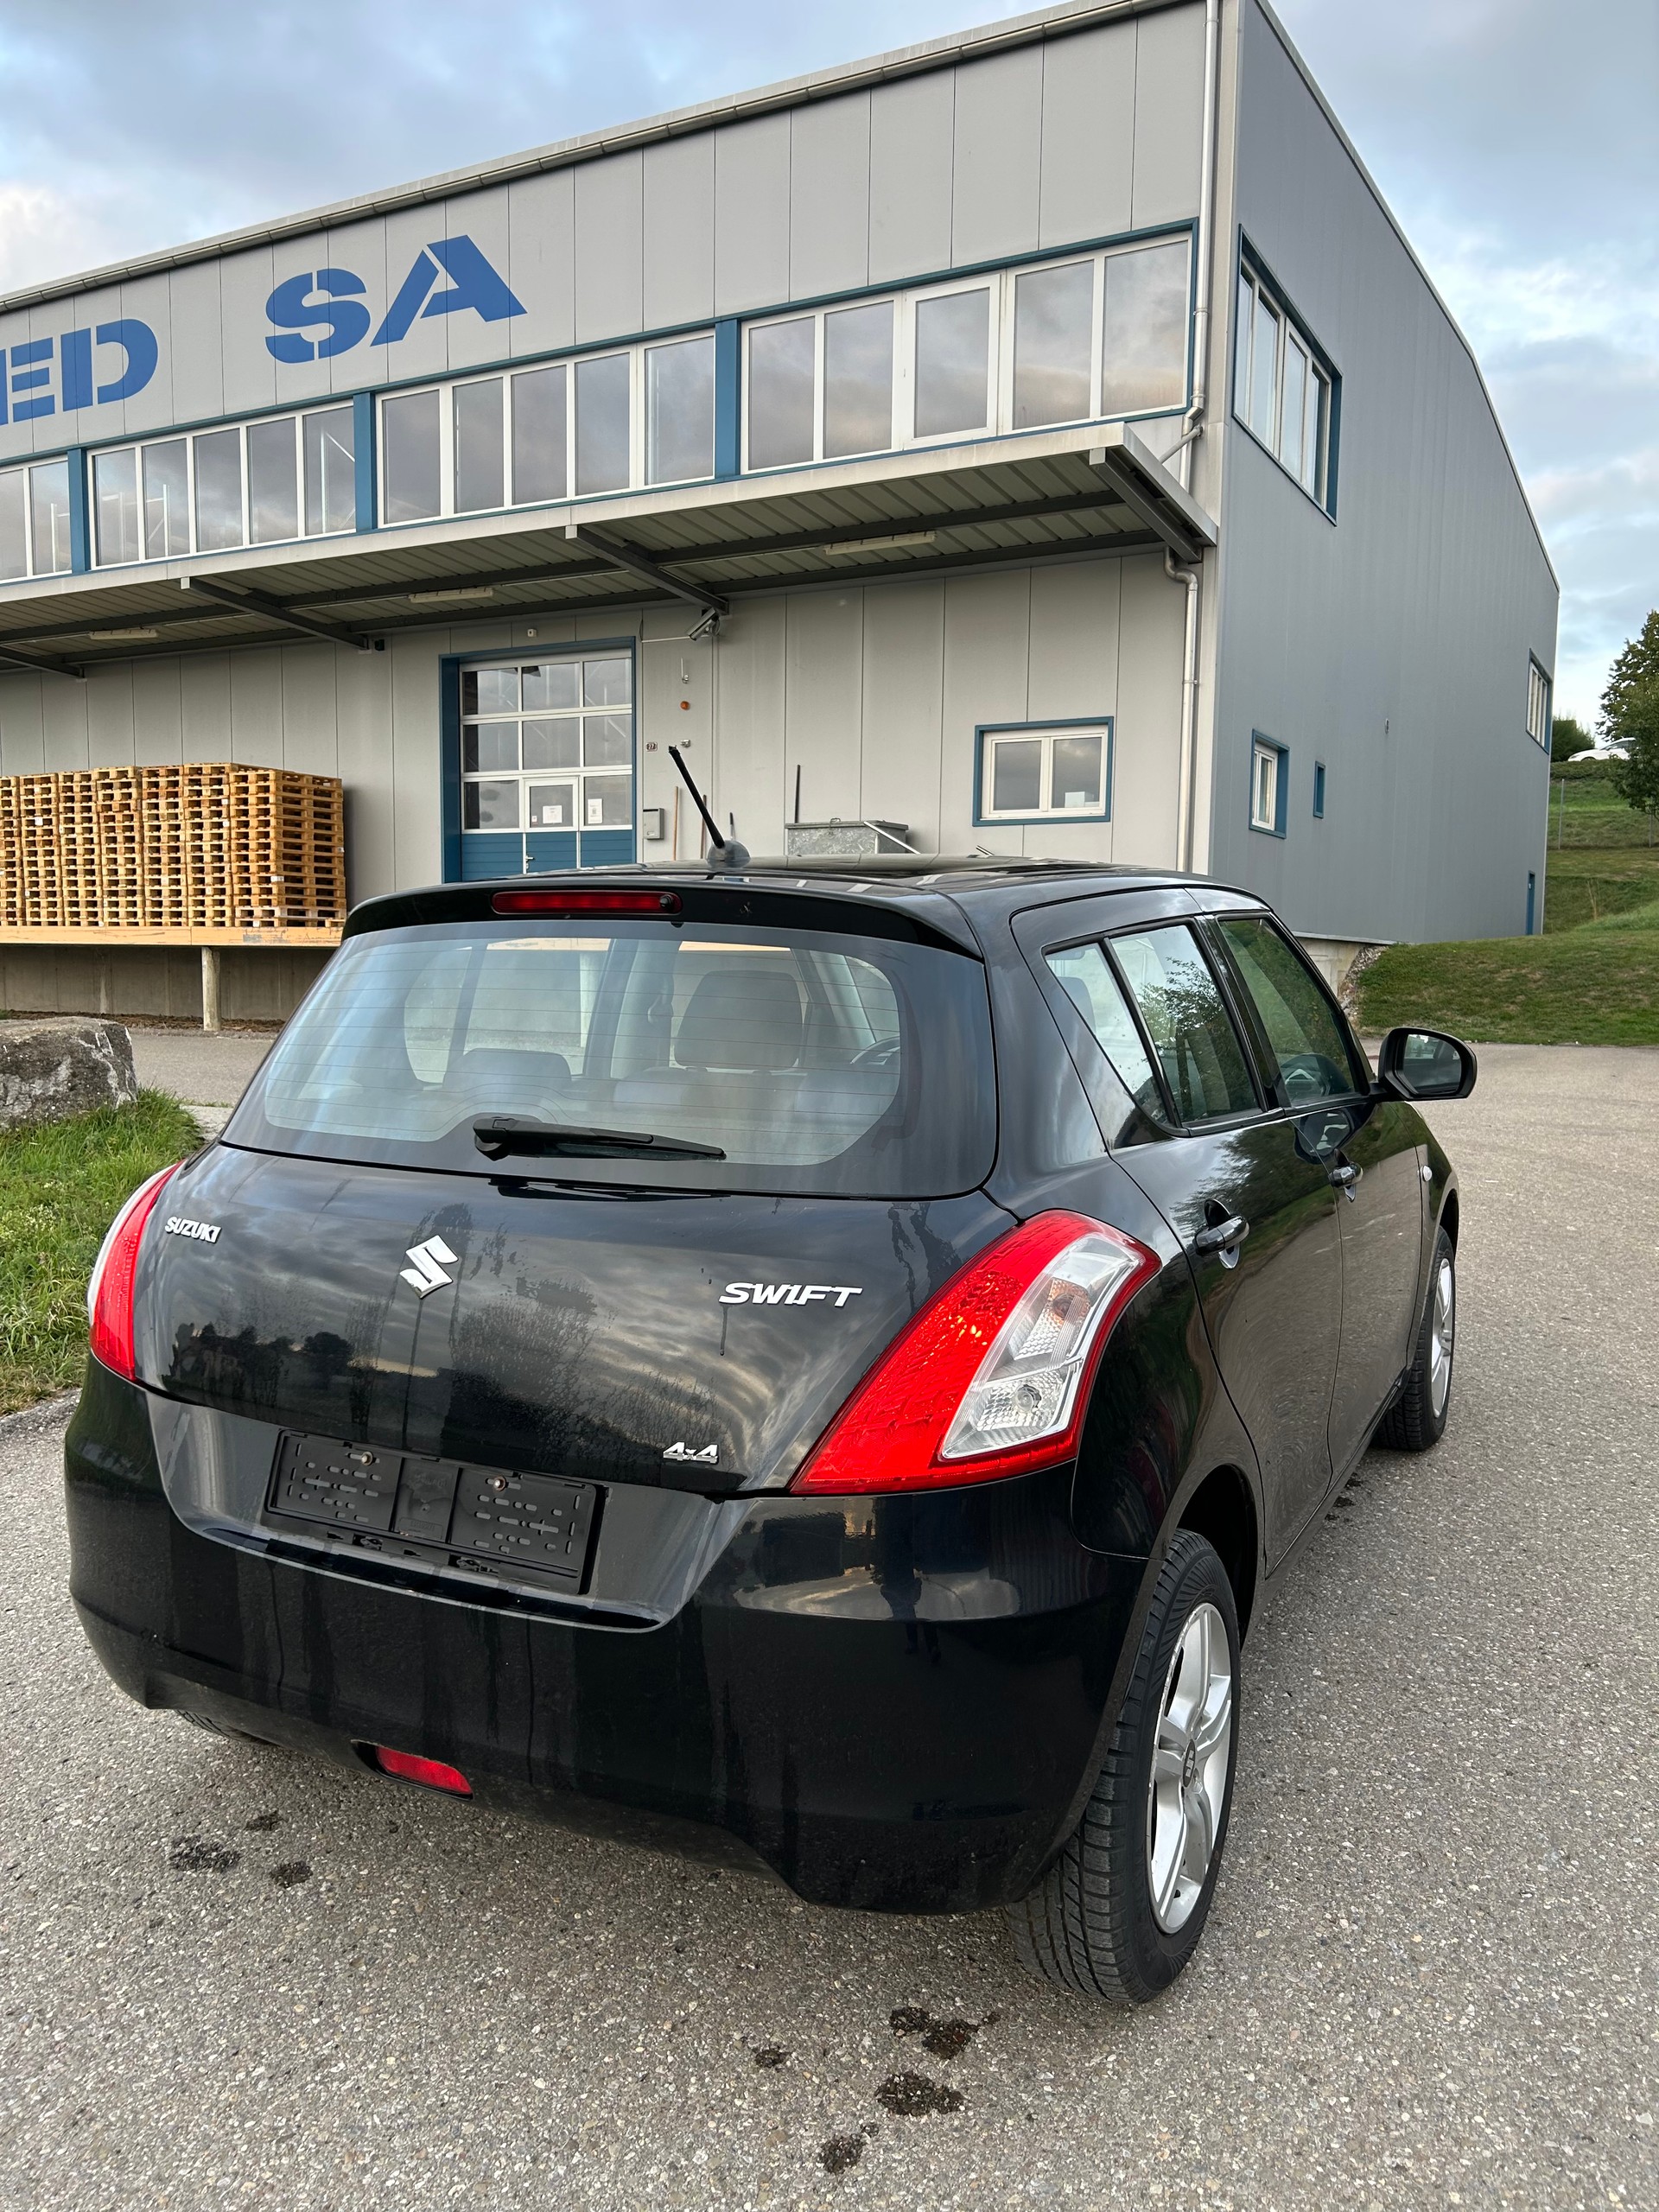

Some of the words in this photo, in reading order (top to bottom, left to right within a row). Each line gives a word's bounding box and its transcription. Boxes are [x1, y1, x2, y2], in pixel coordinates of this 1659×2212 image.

[264, 235, 528, 364] SA
[164, 1216, 222, 1243] SUZUKI
[718, 1282, 863, 1307] SWIFT
